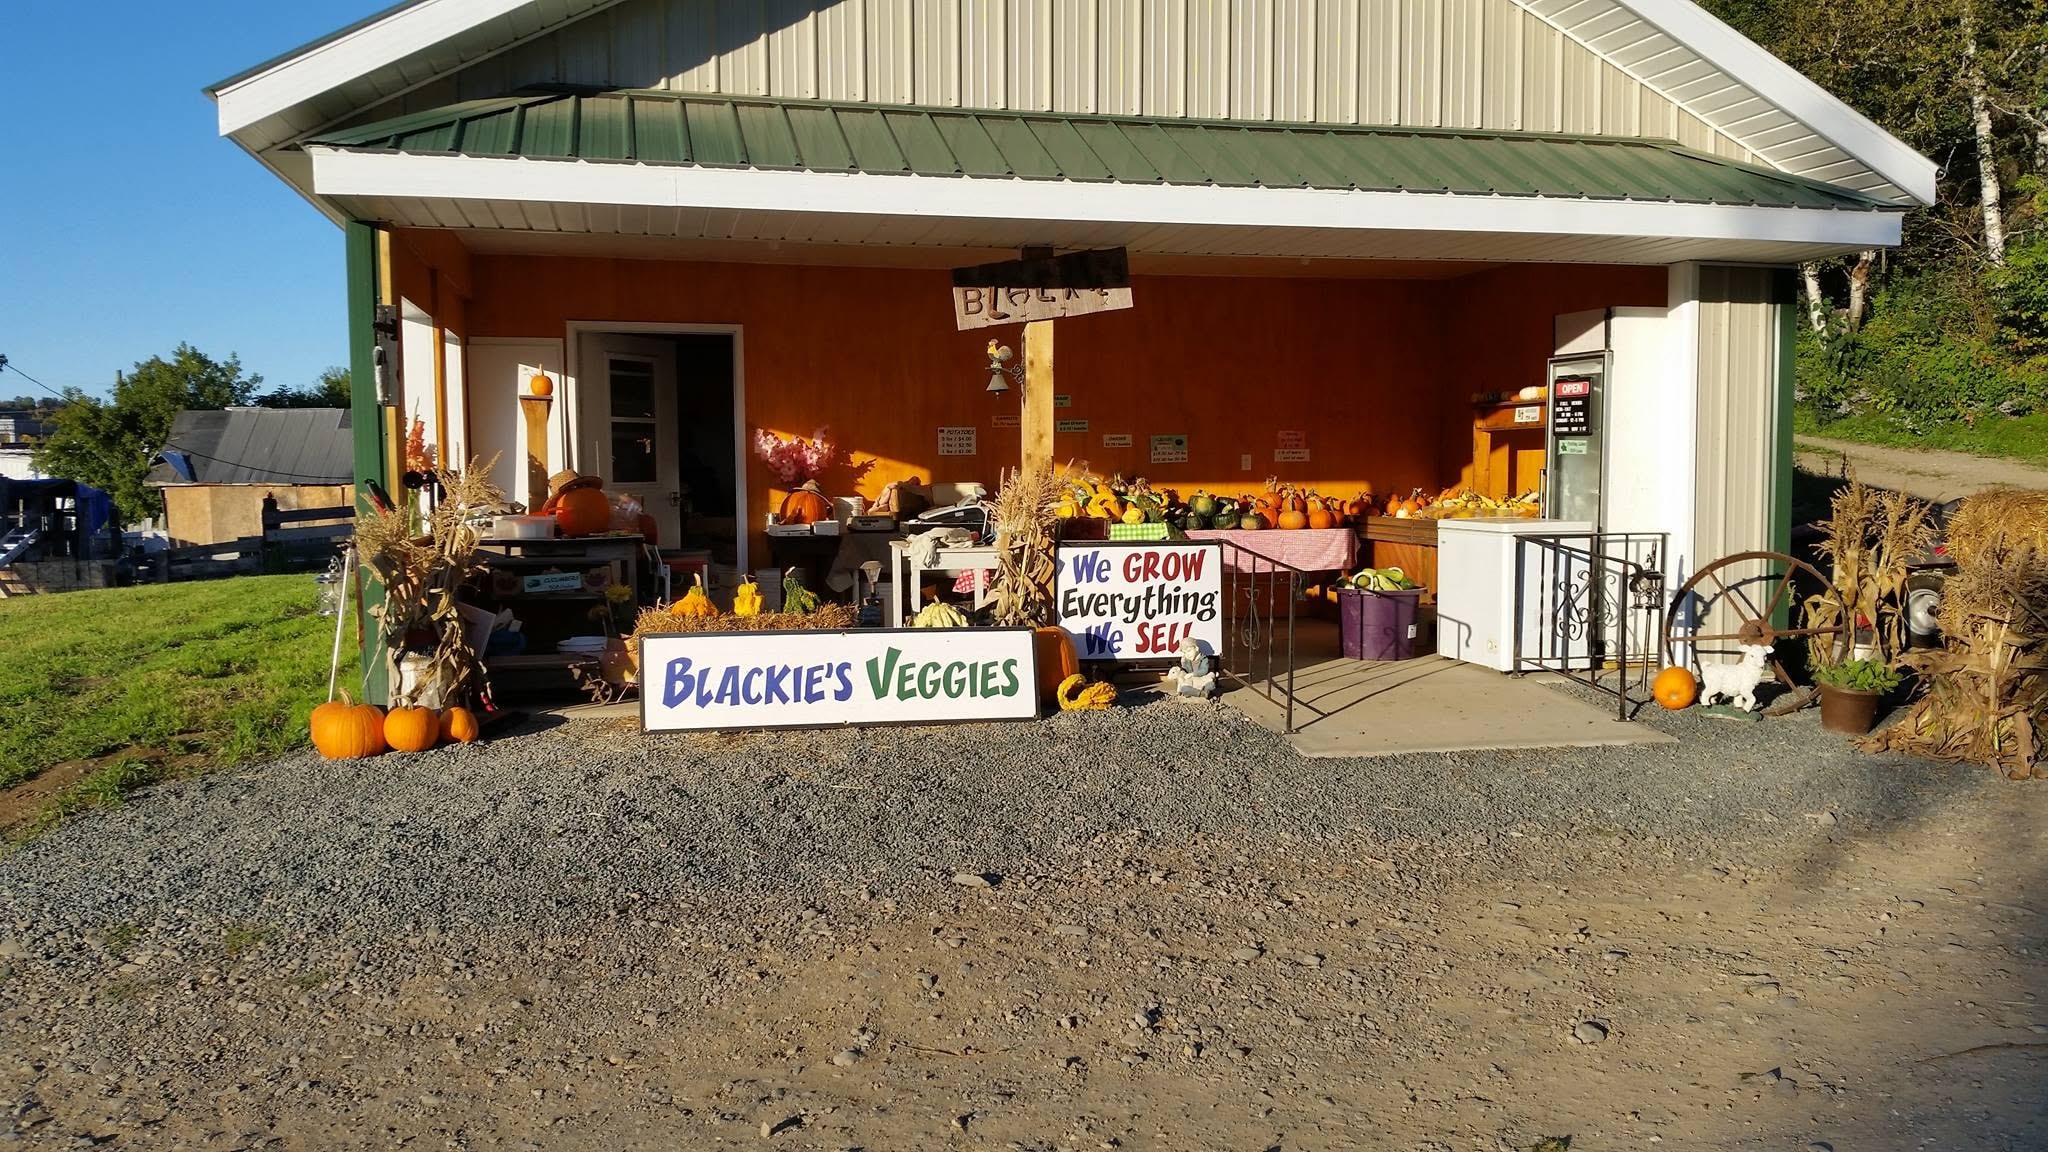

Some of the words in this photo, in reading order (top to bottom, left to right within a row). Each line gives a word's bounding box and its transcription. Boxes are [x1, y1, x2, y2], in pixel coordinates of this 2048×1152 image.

[1562, 383, 1583, 394] OPEN
[1072, 550, 1111, 585] We
[1123, 549, 1207, 584] GROW
[1061, 583, 1219, 624] Everything
[1085, 622, 1124, 656] We
[662, 656, 854, 709] BLACKIE'S
[866, 646, 1020, 702] VEGGIES
